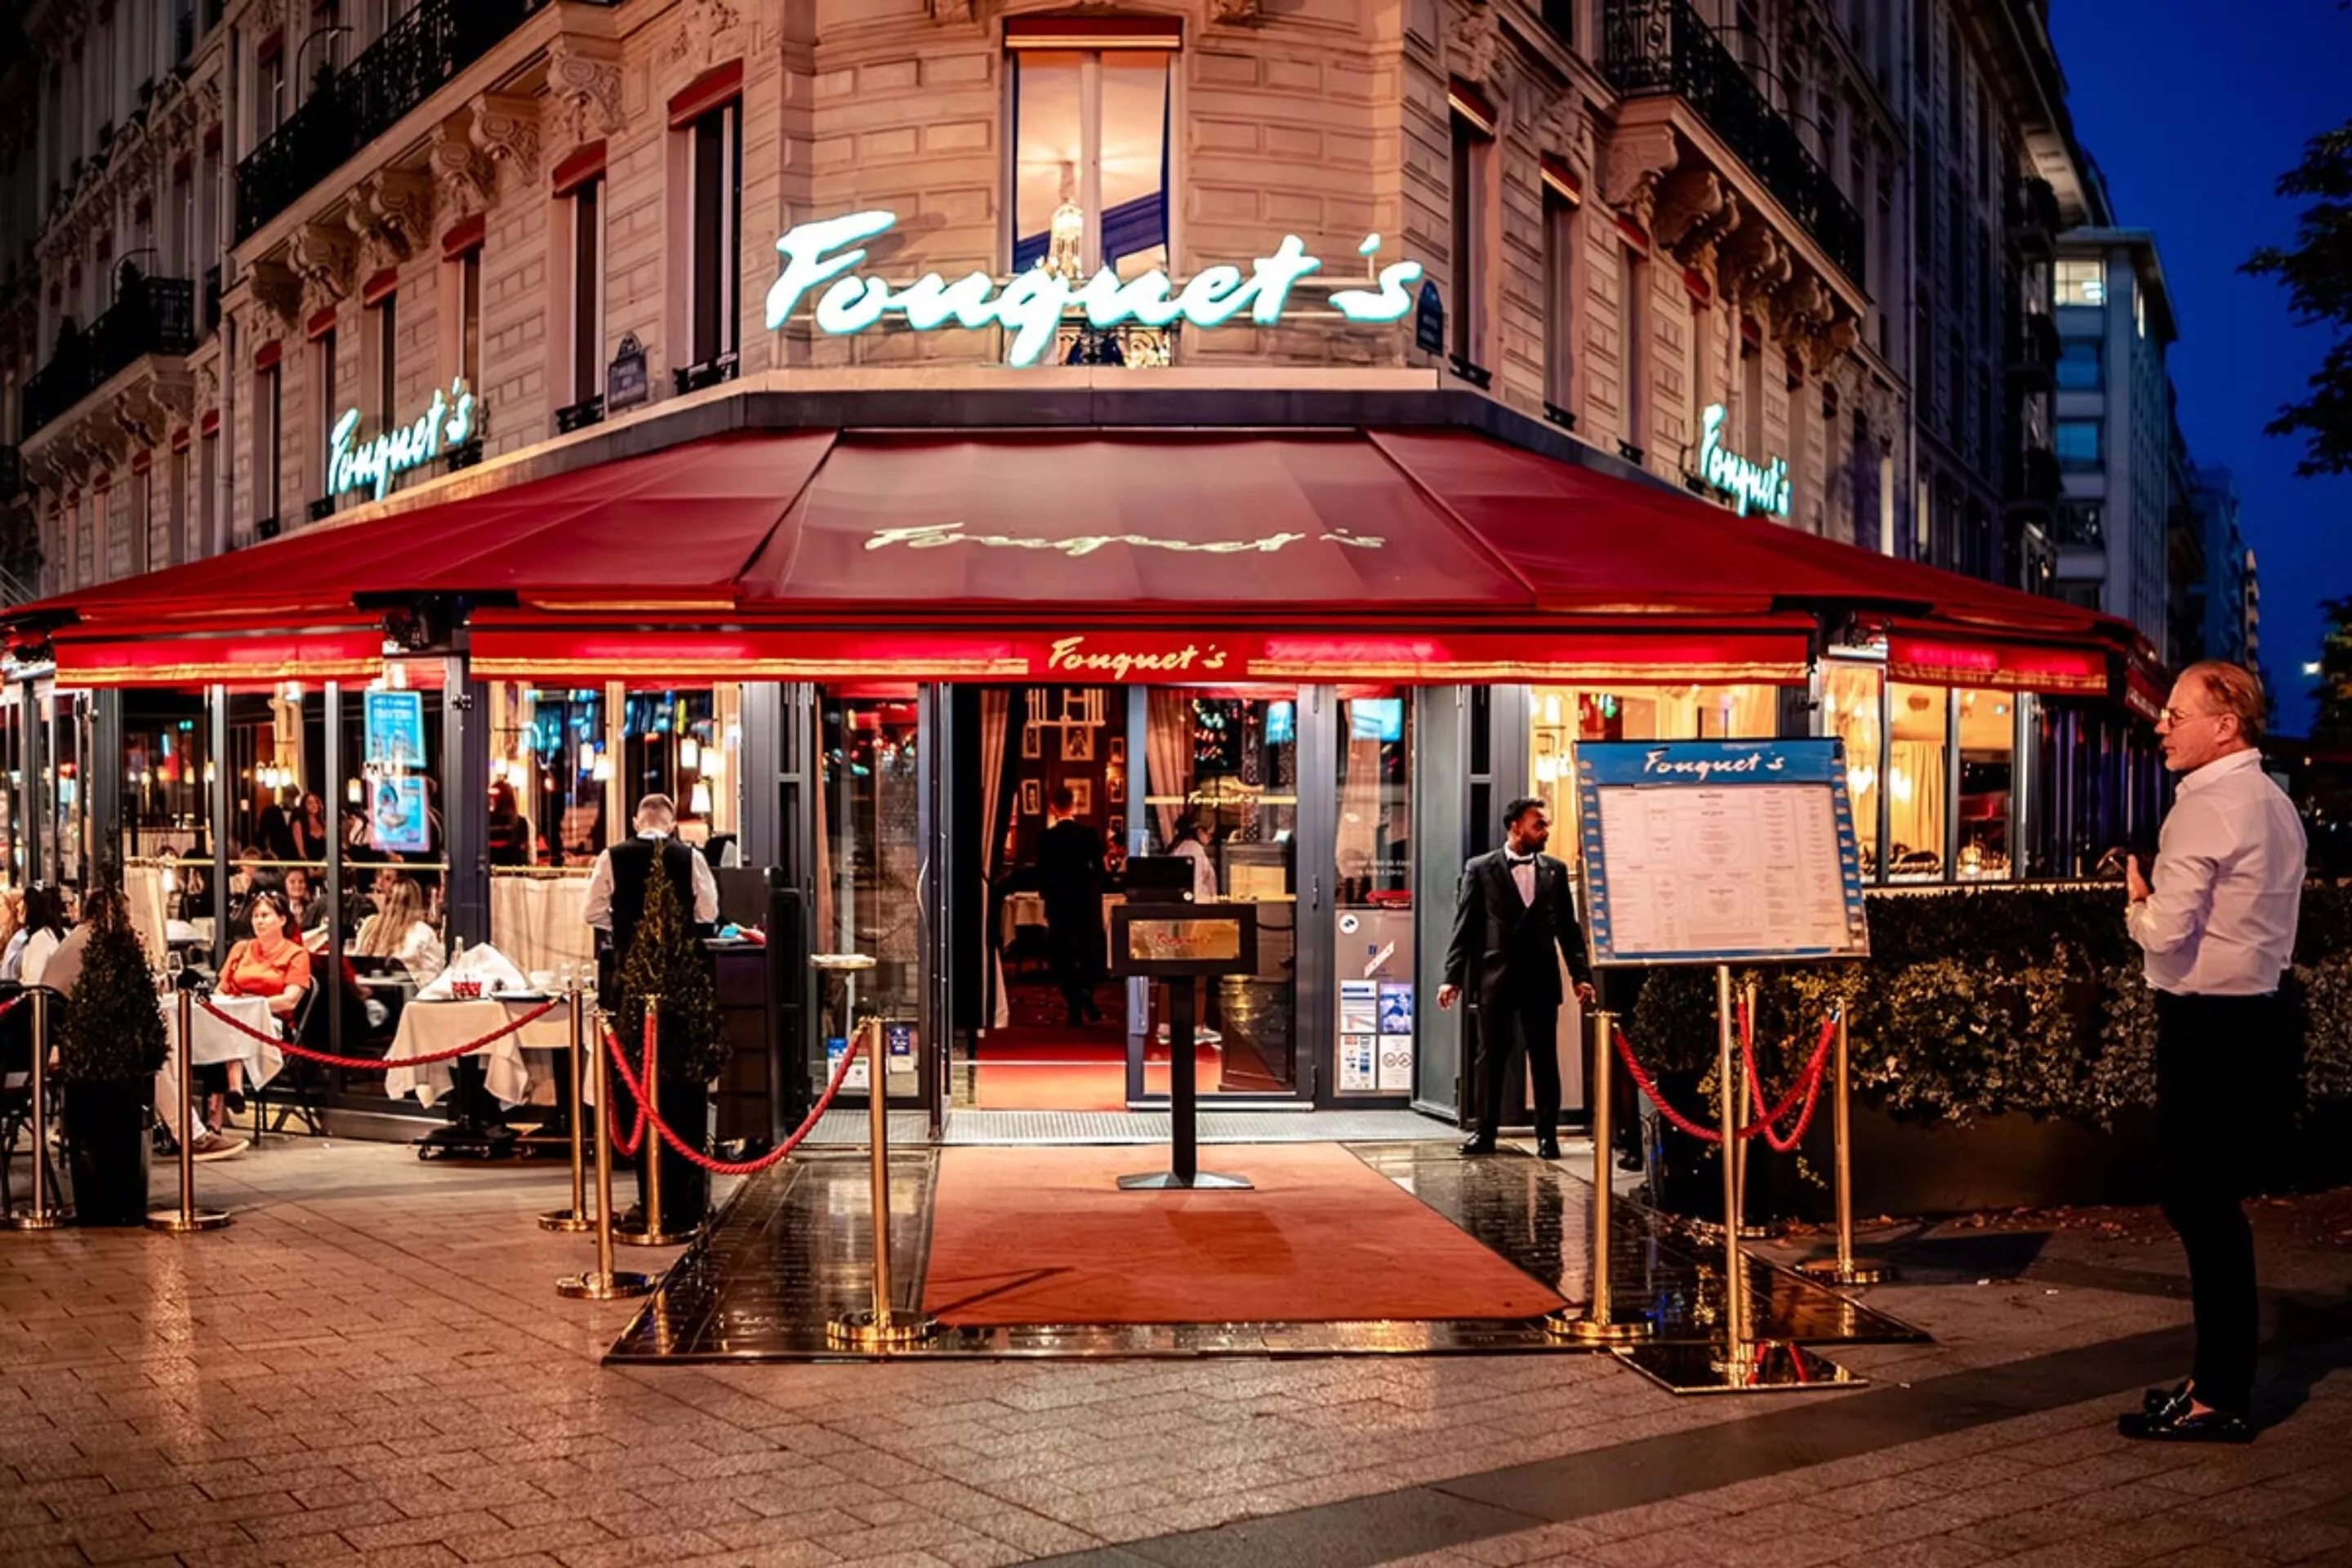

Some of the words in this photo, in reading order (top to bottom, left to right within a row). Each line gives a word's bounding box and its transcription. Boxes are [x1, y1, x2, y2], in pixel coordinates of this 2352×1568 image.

[765, 210, 1423, 370] Fouquet's
[328, 376, 472, 502] Fouquet's
[865, 521, 1385, 555] Fouquet's
[1048, 635, 1227, 680] Fouquet's
[1643, 746, 1785, 781] Fouquet's
